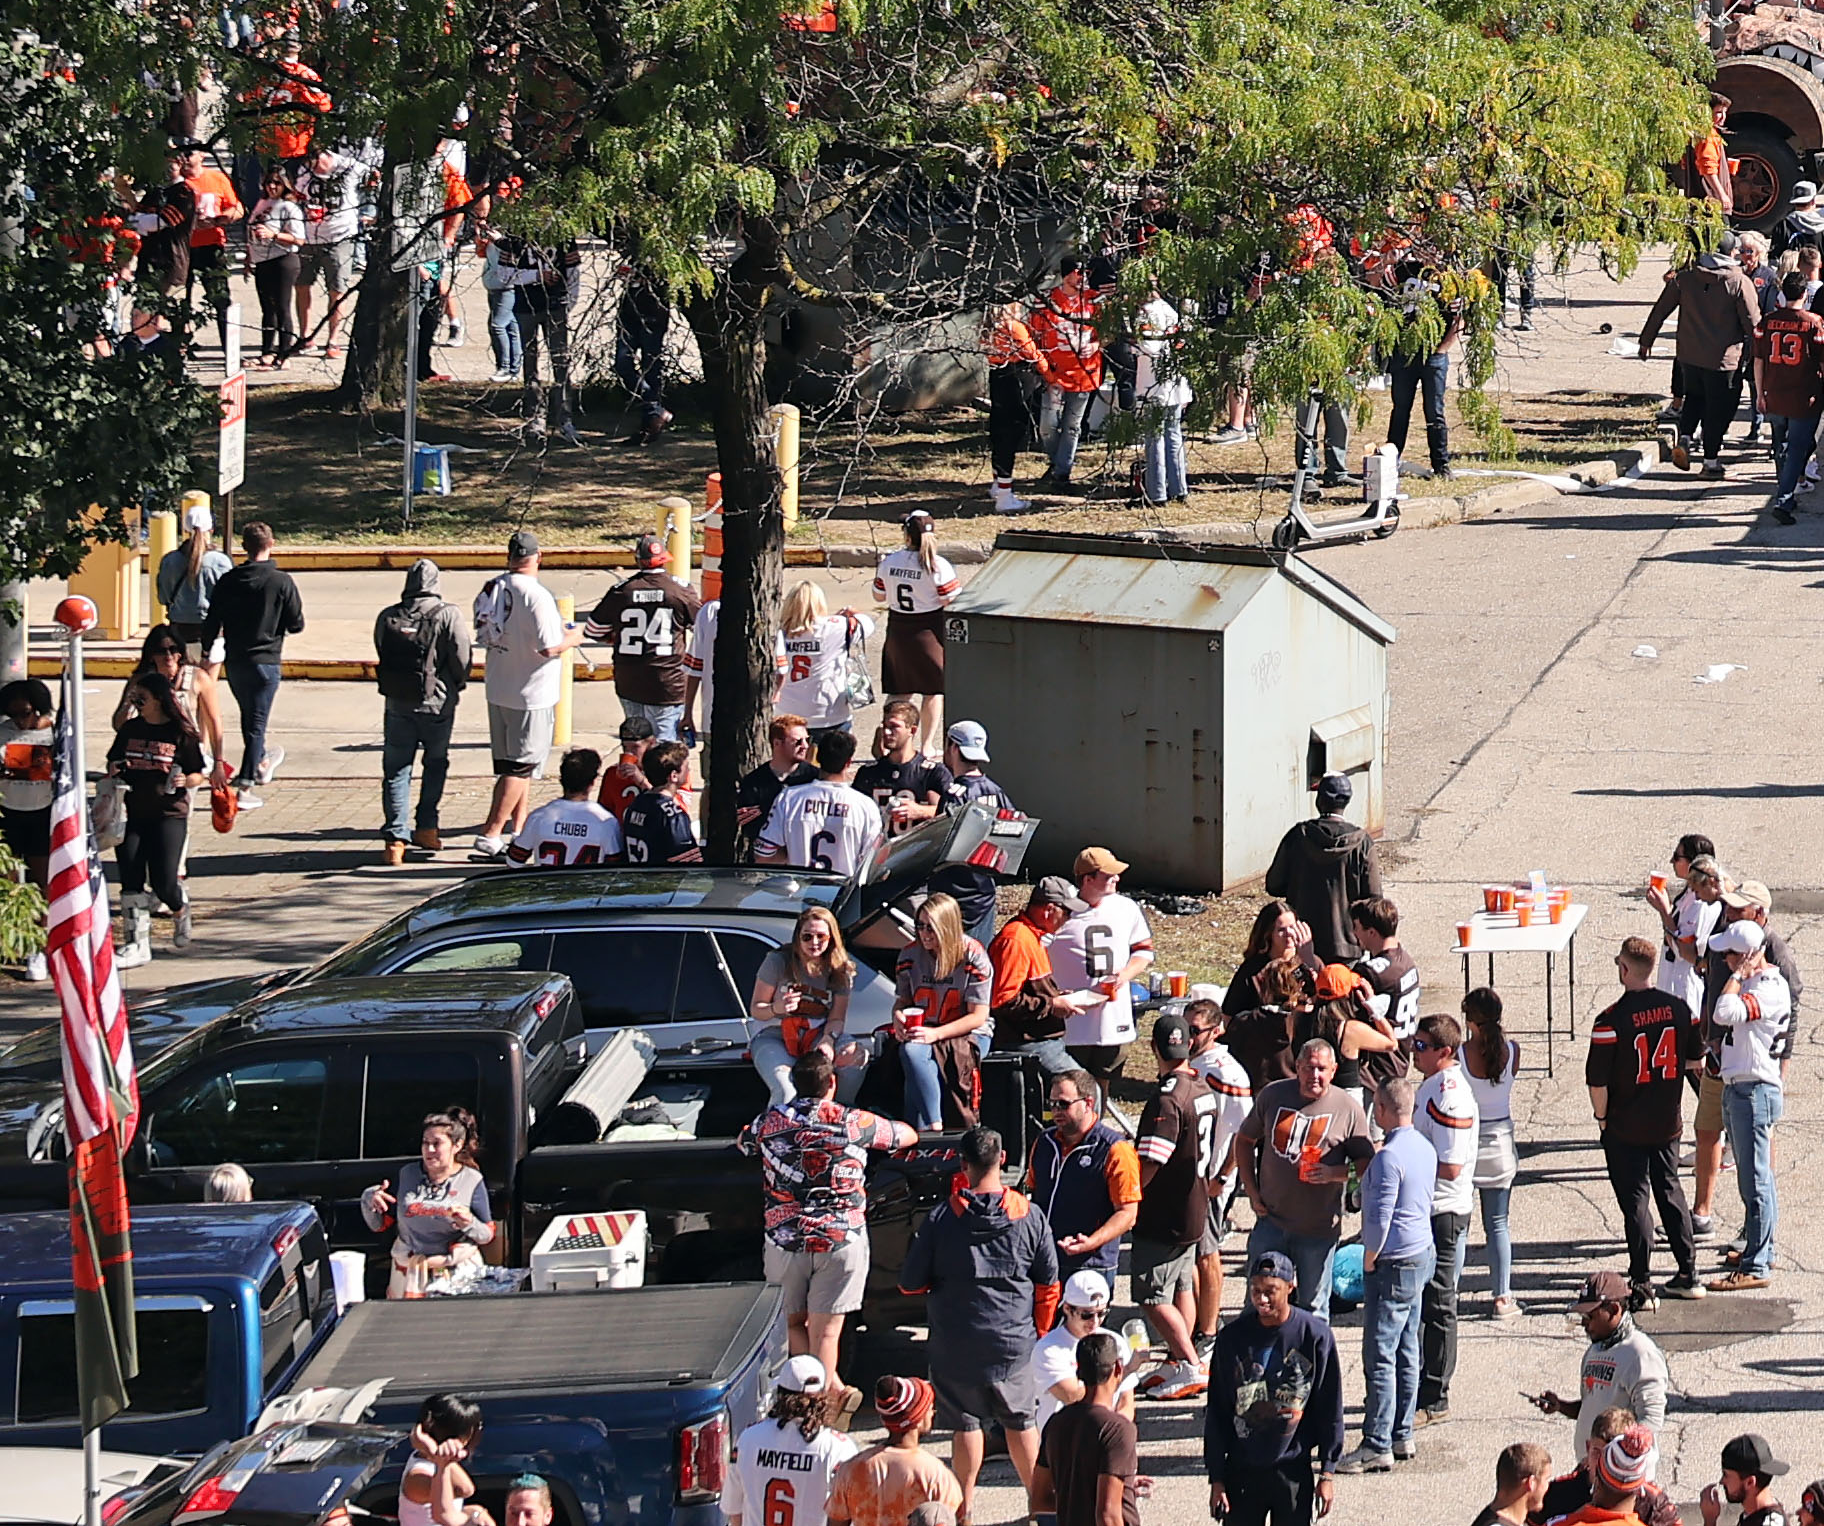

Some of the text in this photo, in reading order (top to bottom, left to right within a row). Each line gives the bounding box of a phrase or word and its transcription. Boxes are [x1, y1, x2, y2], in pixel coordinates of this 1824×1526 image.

[1768, 332, 1803, 365] 13
[889, 568, 921, 580] MAYFIELD
[632, 590, 665, 602] CHUBB
[897, 583, 915, 611] 6
[618, 607, 674, 655] 24
[805, 799, 849, 818] CUTLER
[554, 822, 588, 837] CHUBB
[811, 829, 836, 870] 6
[1083, 923, 1115, 978] 6
[913, 987, 961, 1024] 24
[1631, 1006, 1674, 1029] SHAMIS
[1633, 1026, 1677, 1085] 14
[1196, 1114, 1215, 1179] 3
[756, 1449, 814, 1472] MAYFIELD
[763, 1477, 796, 1526] 6
